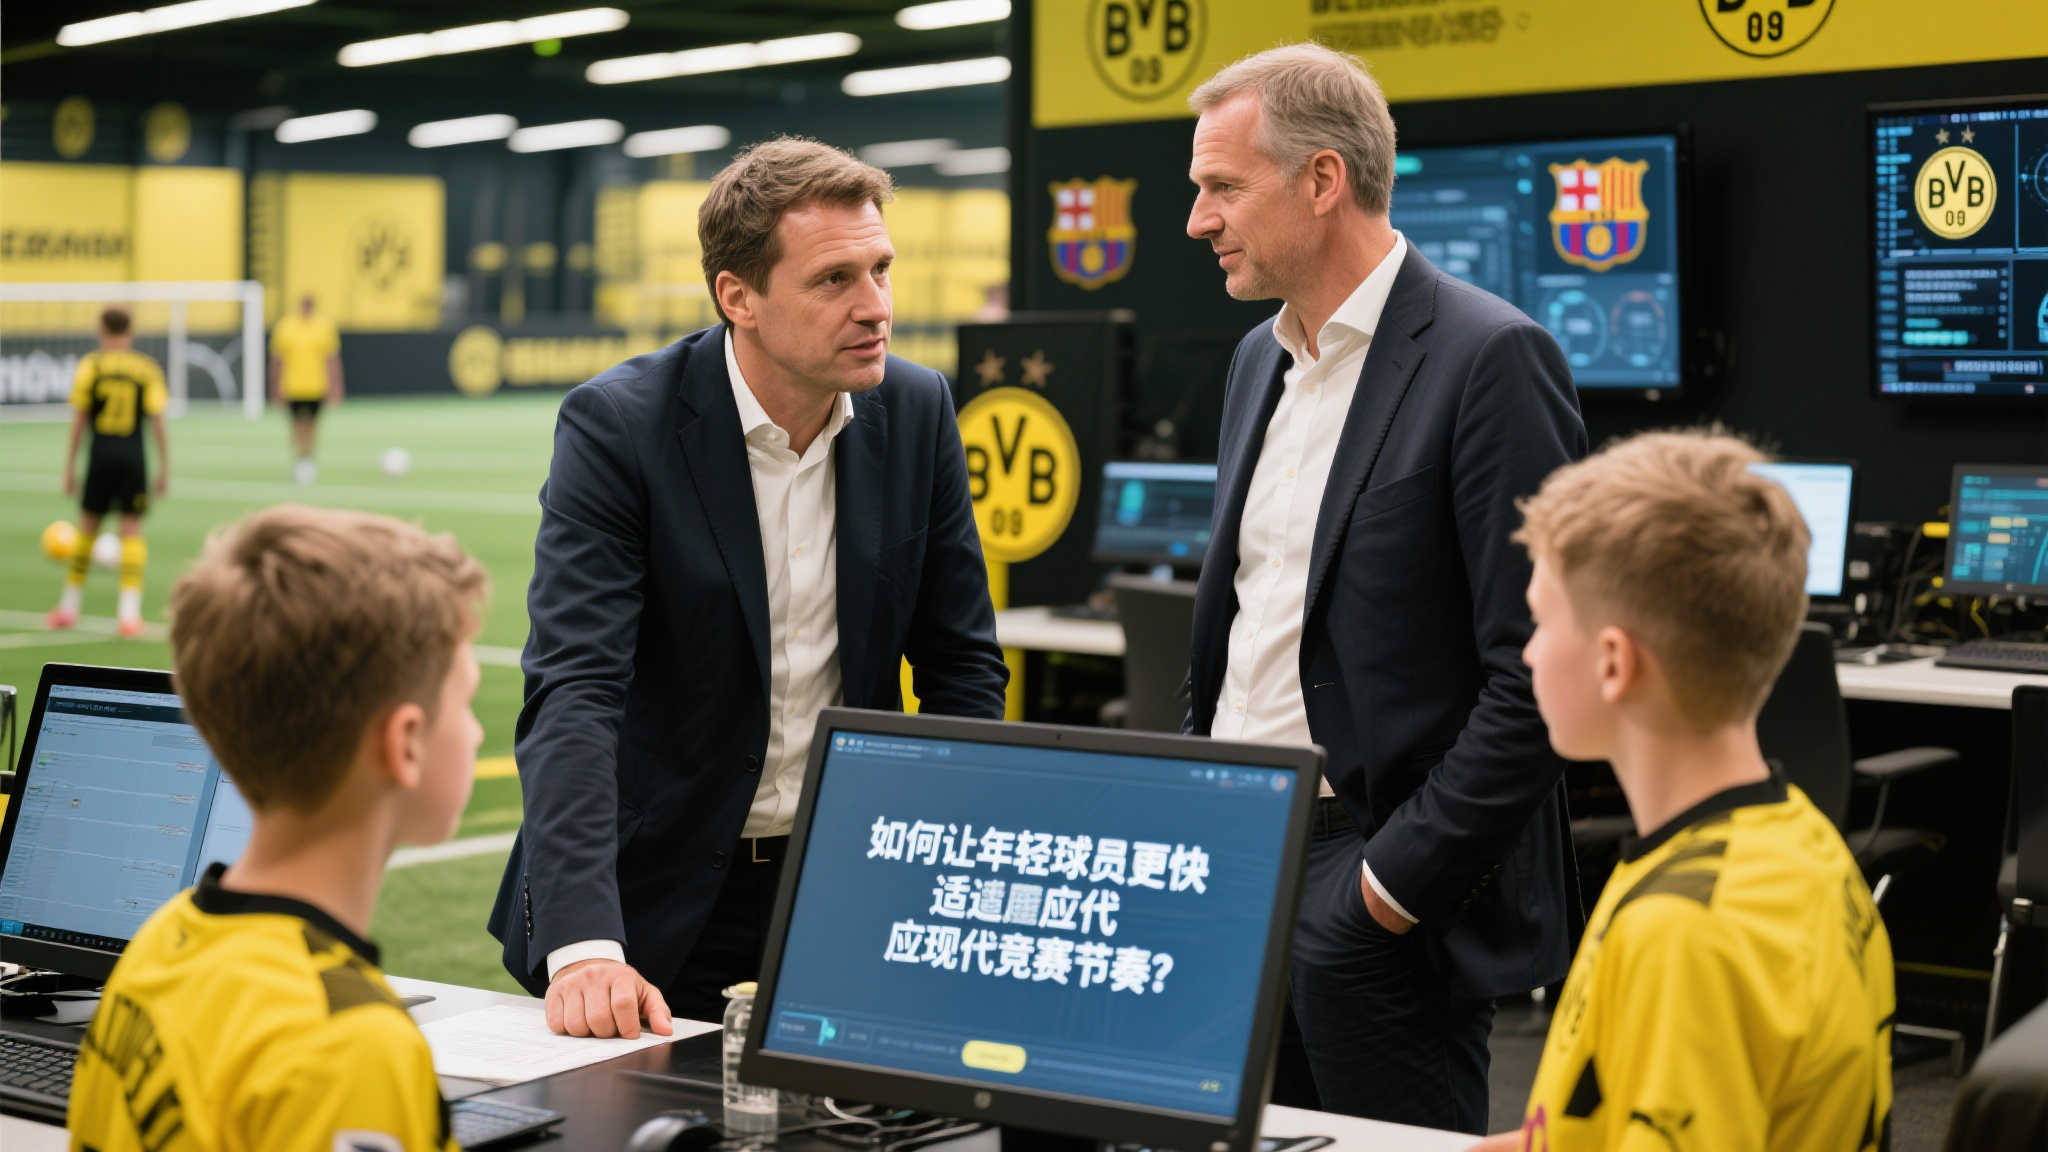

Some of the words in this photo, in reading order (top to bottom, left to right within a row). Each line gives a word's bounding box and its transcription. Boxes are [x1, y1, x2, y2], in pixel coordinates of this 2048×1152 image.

[1747, 11, 1784, 43] 09
[1928, 160, 1985, 208] BVB
[964, 414, 1057, 506] BVB
[866, 815, 1210, 895] 如何让年轻球员更快
